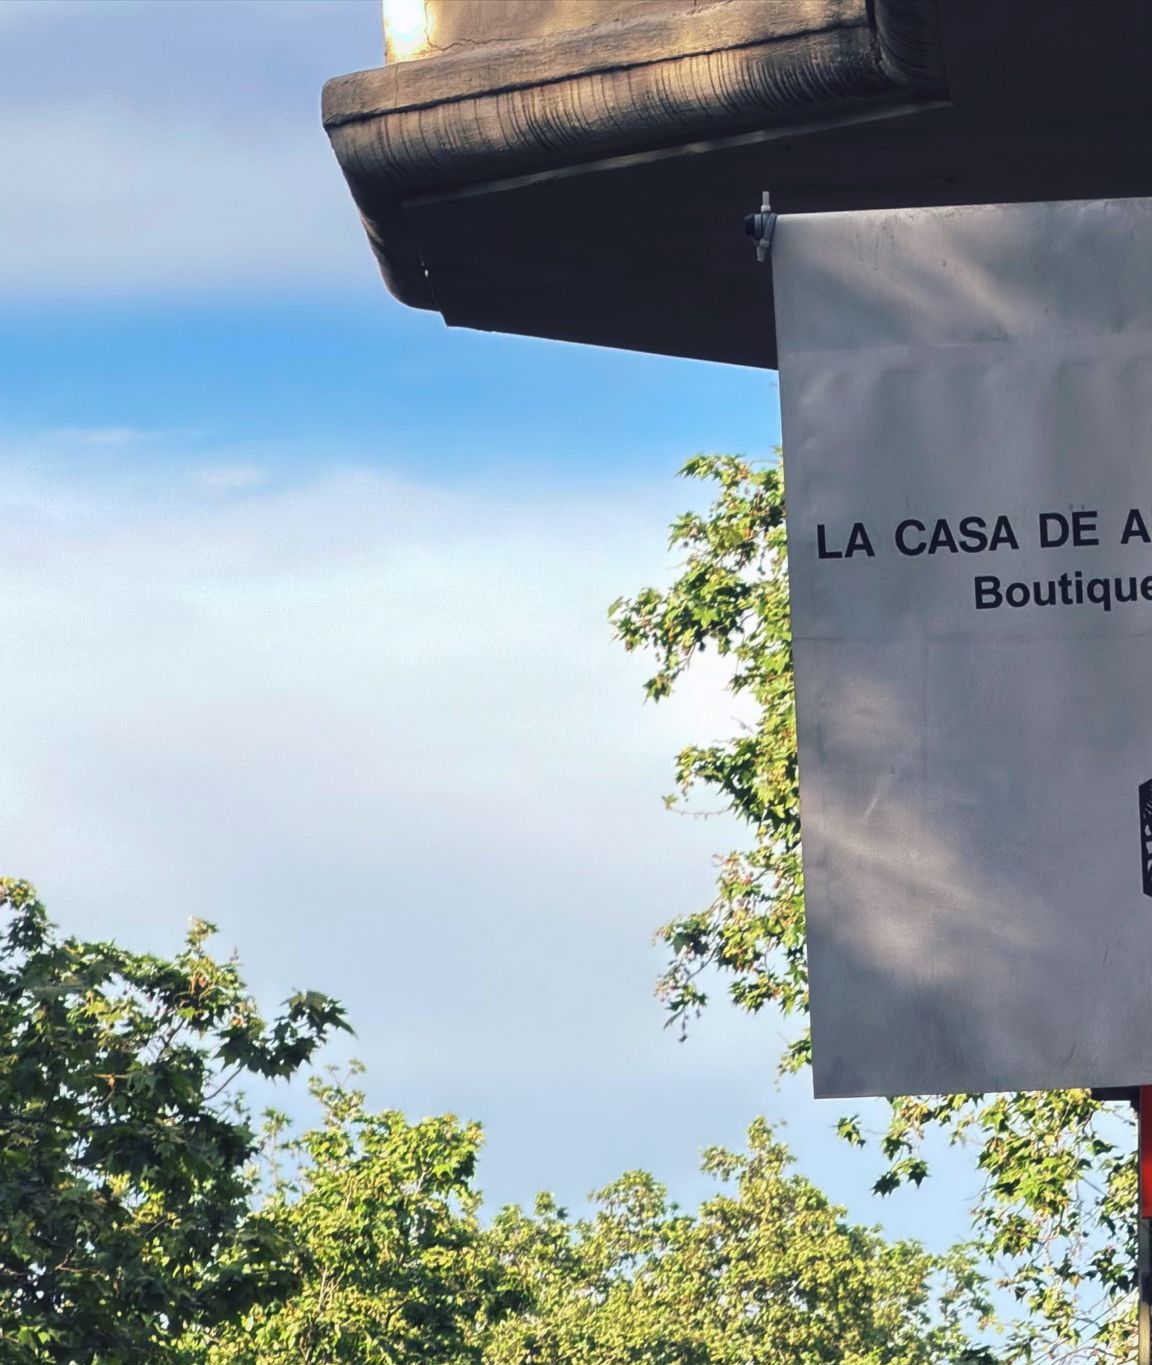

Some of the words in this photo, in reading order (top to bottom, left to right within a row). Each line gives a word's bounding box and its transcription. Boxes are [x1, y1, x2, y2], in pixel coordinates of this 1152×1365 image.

[818, 523, 876, 560] LA
[894, 515, 1019, 557] CASA
[1038, 510, 1099, 549] DE
